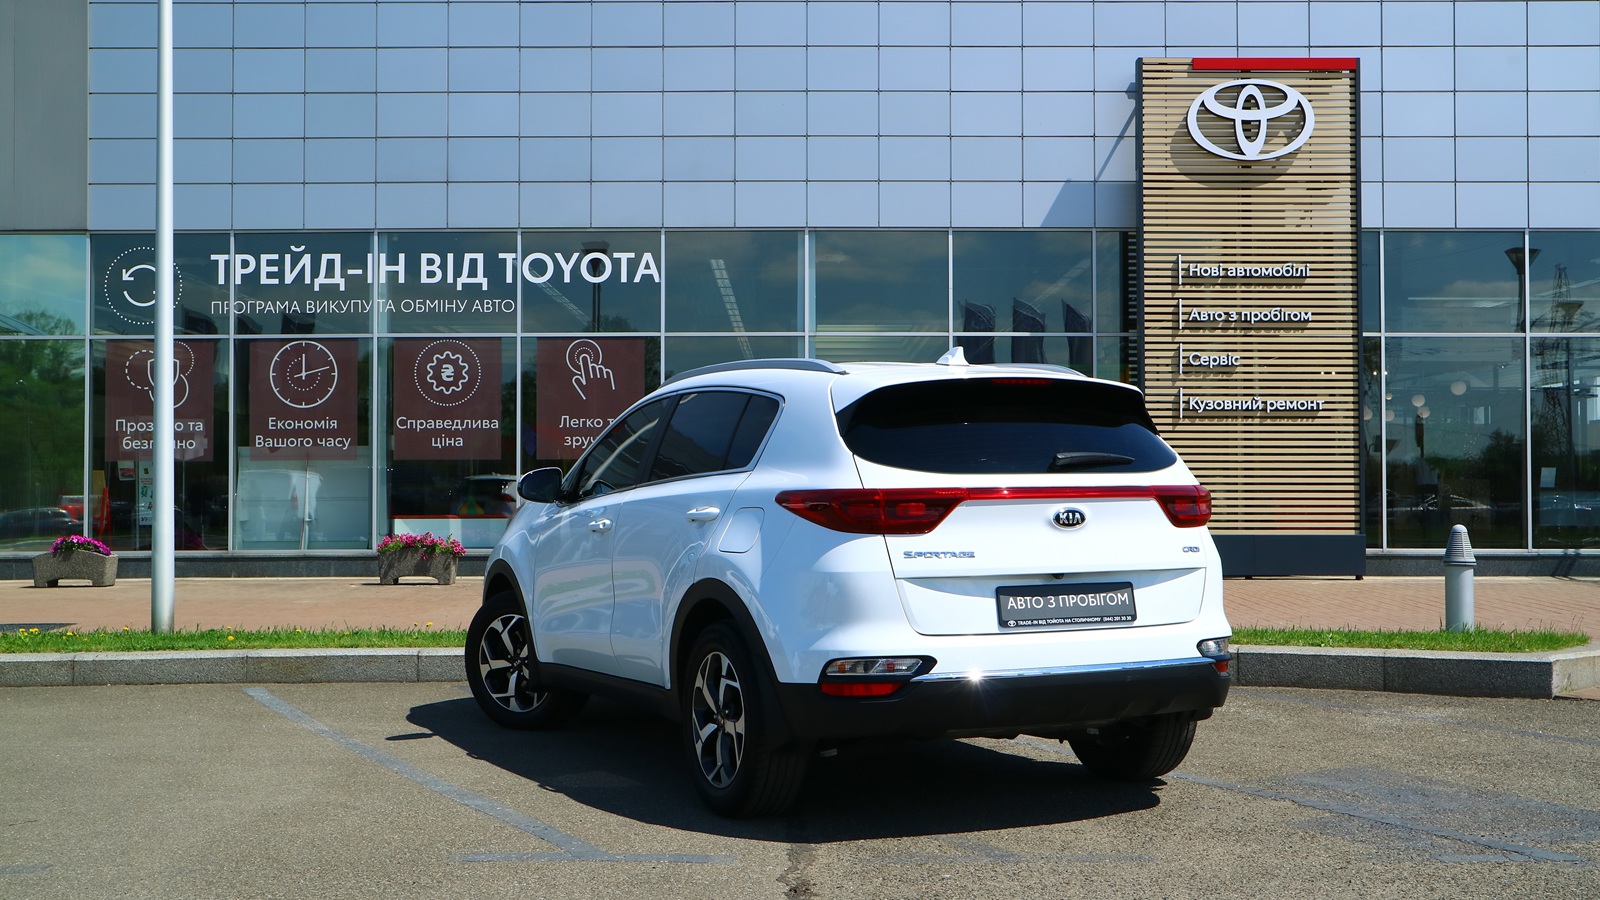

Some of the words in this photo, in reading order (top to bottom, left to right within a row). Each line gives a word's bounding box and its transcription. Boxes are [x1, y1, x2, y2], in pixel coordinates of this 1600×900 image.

[210, 245, 406, 292] ТРЕЙД-ІН
[420, 252, 488, 291] ВІД
[498, 252, 661, 284] TOYOTA
[1189, 263, 1223, 277] Нові
[1227, 263, 1310, 277] автомобілі
[211, 300, 301, 315] ПРОГРАМА
[306, 299, 373, 314] ВИКУПУ
[377, 299, 396, 313] ТА
[400, 299, 467, 313] ОБМІНУ
[471, 299, 515, 313] АВТО
[1189, 308, 1225, 322] Авто
[1228, 313, 1237, 321] з
[1241, 307, 1312, 324] пробігом
[1189, 352, 1241, 368] Сервіс
[1189, 397, 1262, 413] Кузовний
[1267, 399, 1325, 413] ремонт
[115, 419, 184, 434] Прозо
[188, 421, 204, 431] та
[267, 417, 338, 430] Економія
[396, 416, 499, 433] Справедлива
[559, 415, 603, 428] Легко
[122, 436, 196, 449] безно
[255, 435, 314, 448] Вашого
[316, 436, 351, 451] часу
[431, 434, 464, 449] ціна
[1059, 512, 1082, 524] KIA
[903, 550, 976, 559] SPORTAGE
[1007, 596, 1044, 610] АВТО
[1047, 595, 1056, 608] З
[1058, 592, 1129, 608] ПРОБІГОМ
